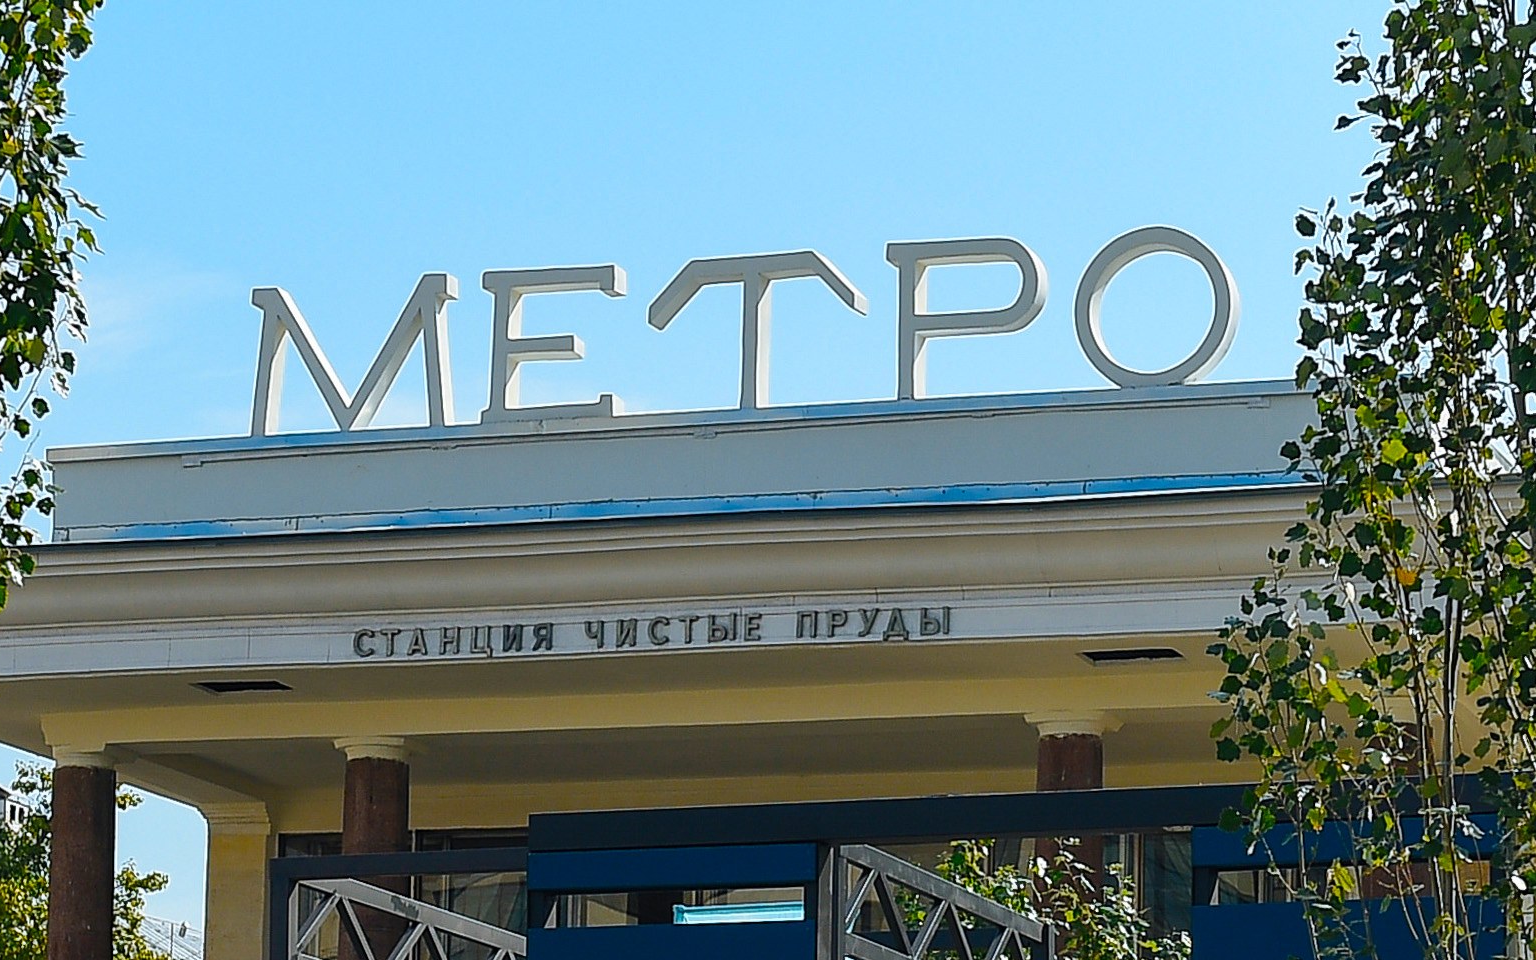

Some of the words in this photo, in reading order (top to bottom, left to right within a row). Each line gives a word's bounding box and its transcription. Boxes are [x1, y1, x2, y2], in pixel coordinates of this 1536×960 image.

[250, 225, 1239, 437] МЕТРО
[353, 621, 555, 659] СТАНЦИЯ
[584, 611, 762, 648] ЧИСТЫЕ
[796, 606, 952, 641] ПРУДЫ
